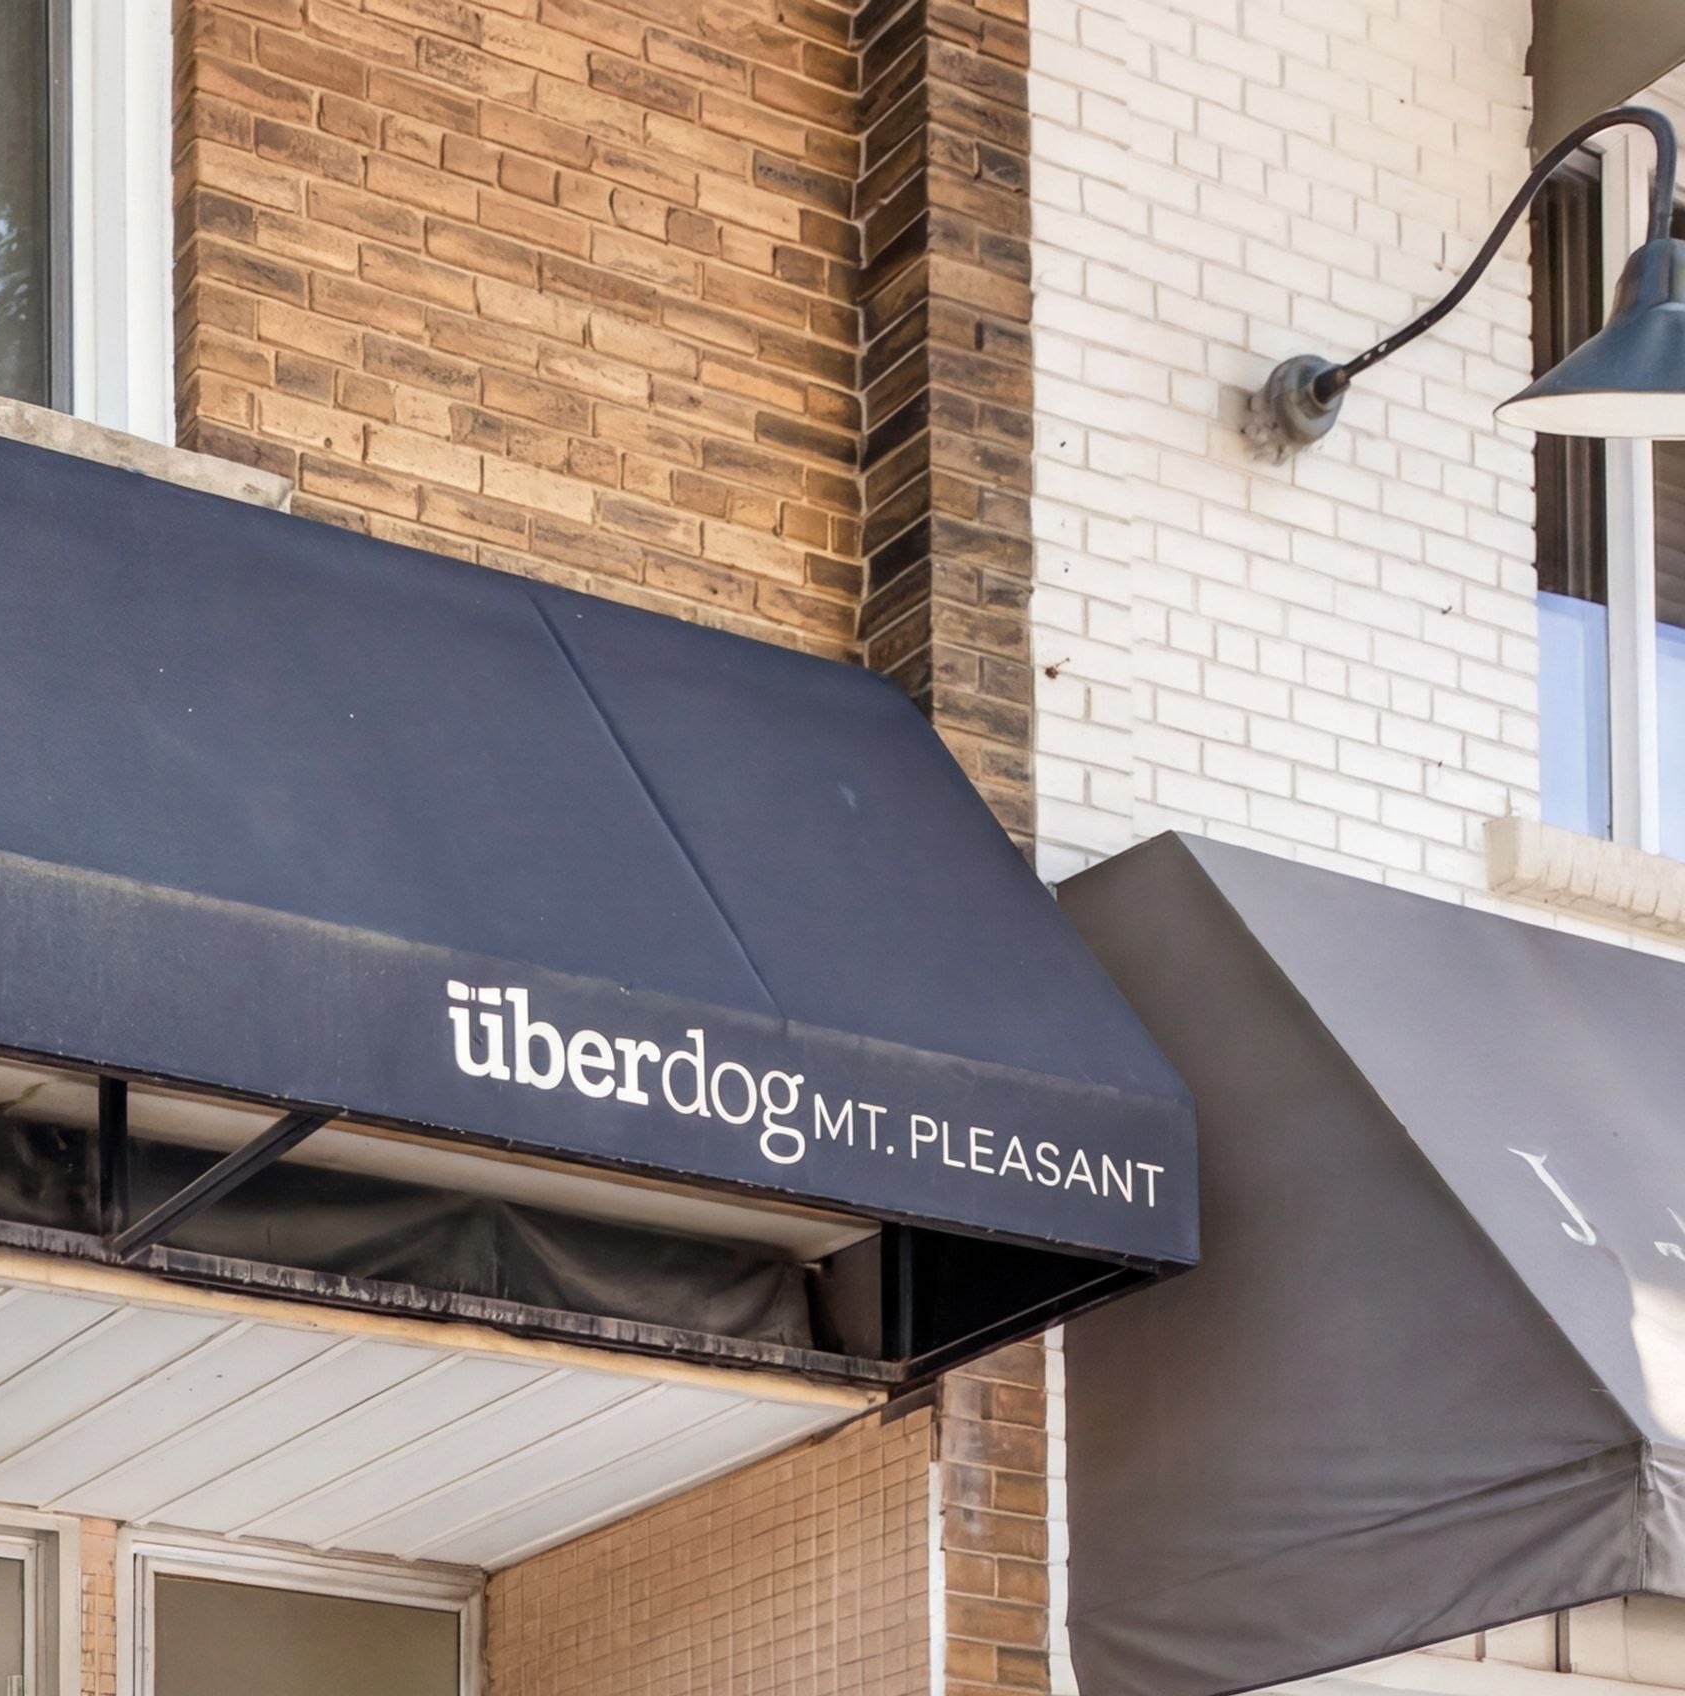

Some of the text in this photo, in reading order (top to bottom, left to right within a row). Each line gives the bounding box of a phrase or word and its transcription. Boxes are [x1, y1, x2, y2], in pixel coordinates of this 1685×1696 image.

[446, 979, 1165, 1208] überdog MT. PLEASANT
